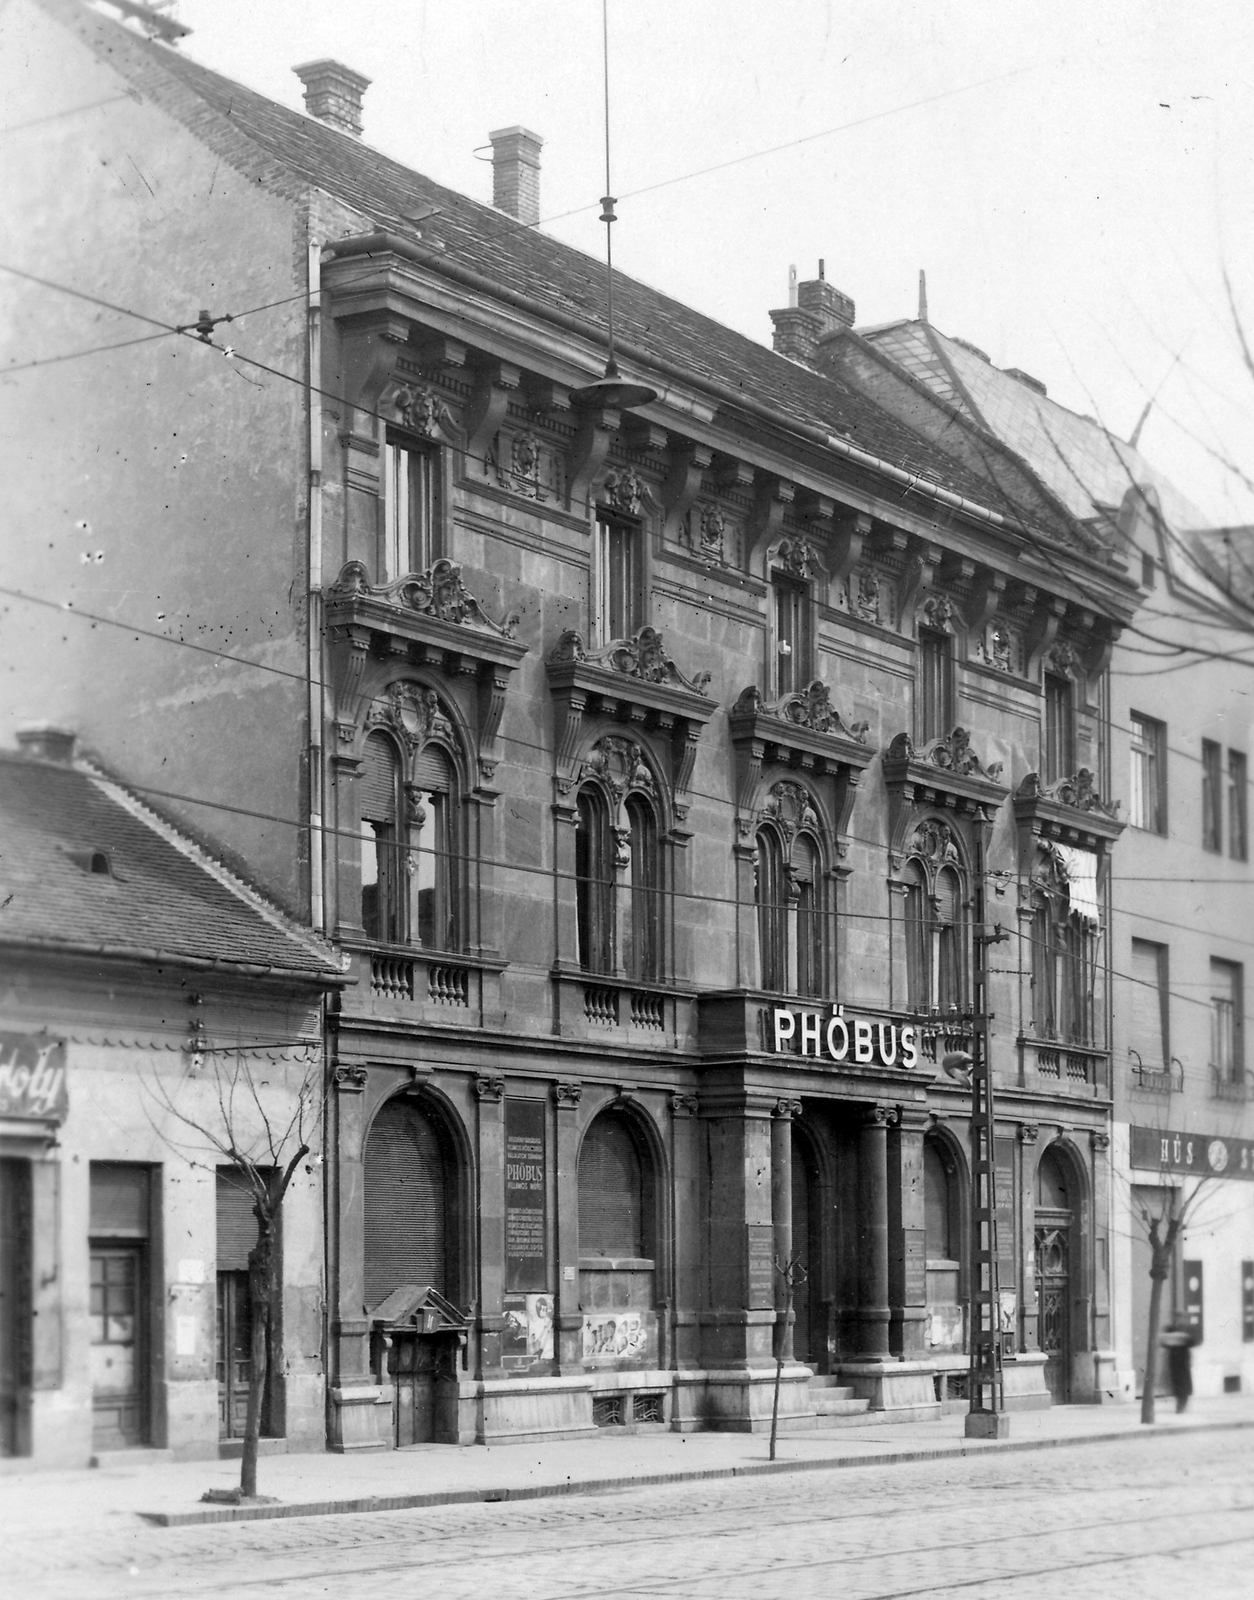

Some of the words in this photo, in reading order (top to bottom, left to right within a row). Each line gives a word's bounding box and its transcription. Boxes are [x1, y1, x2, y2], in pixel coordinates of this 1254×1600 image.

[774, 1004, 918, 1069] PHÖBUS
[1160, 1134, 1194, 1165] HÚS
[506, 1162, 543, 1181] PHÖBUS
